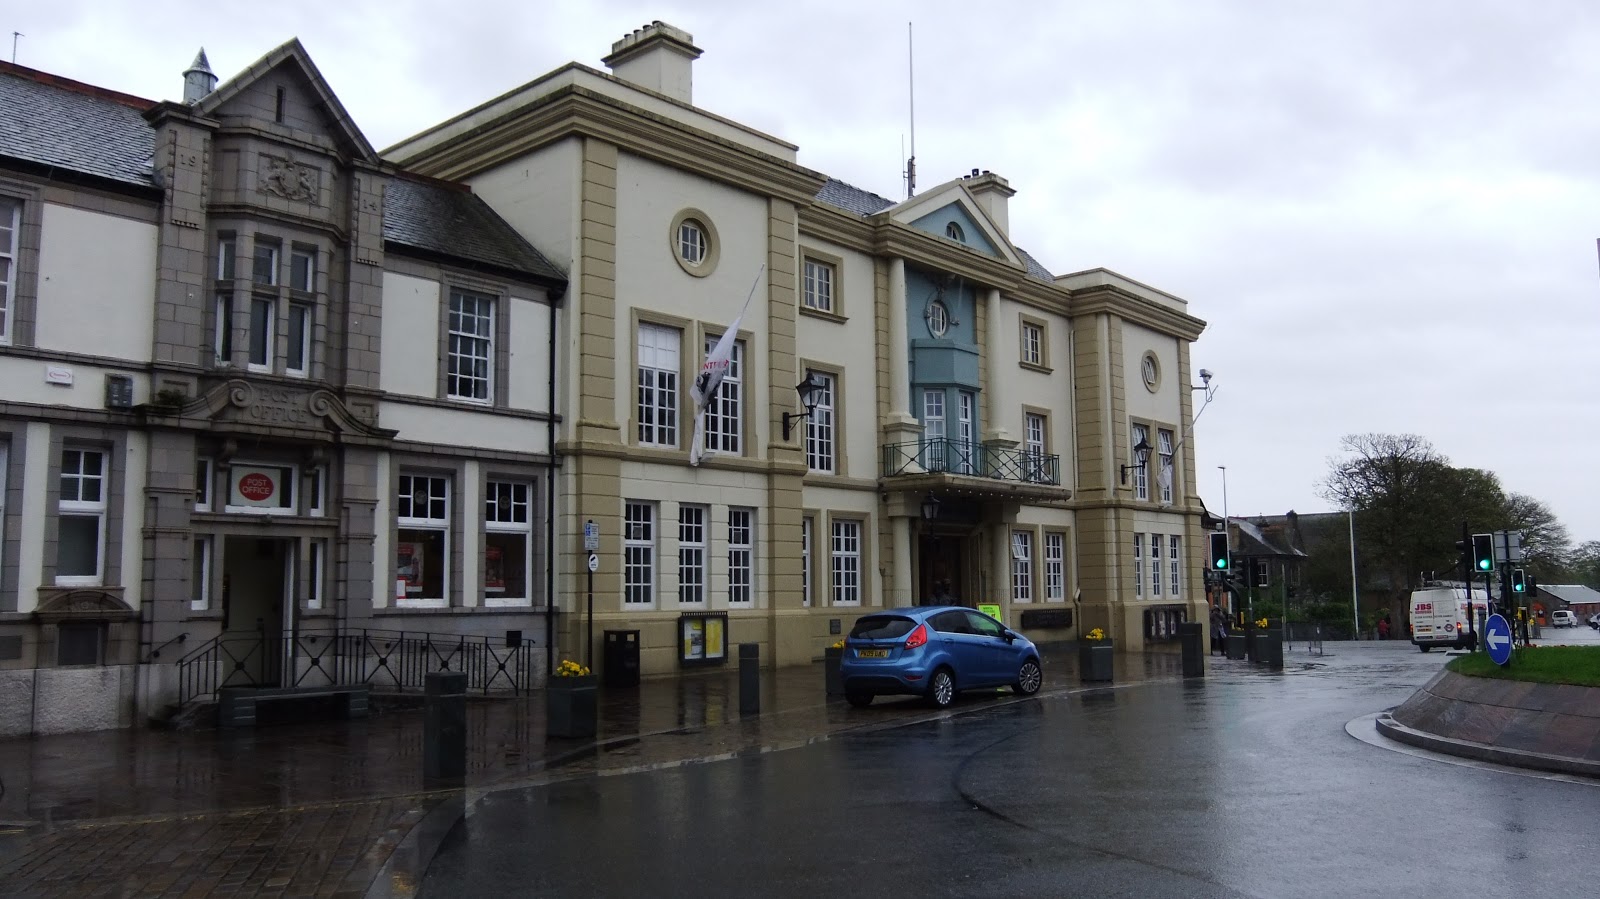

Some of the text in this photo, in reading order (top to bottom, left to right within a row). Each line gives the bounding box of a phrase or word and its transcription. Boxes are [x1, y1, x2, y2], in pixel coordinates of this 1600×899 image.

[258, 387, 300, 405] POST
[250, 405, 308, 424] OFFICE
[242, 486, 270, 495] OFFICE
